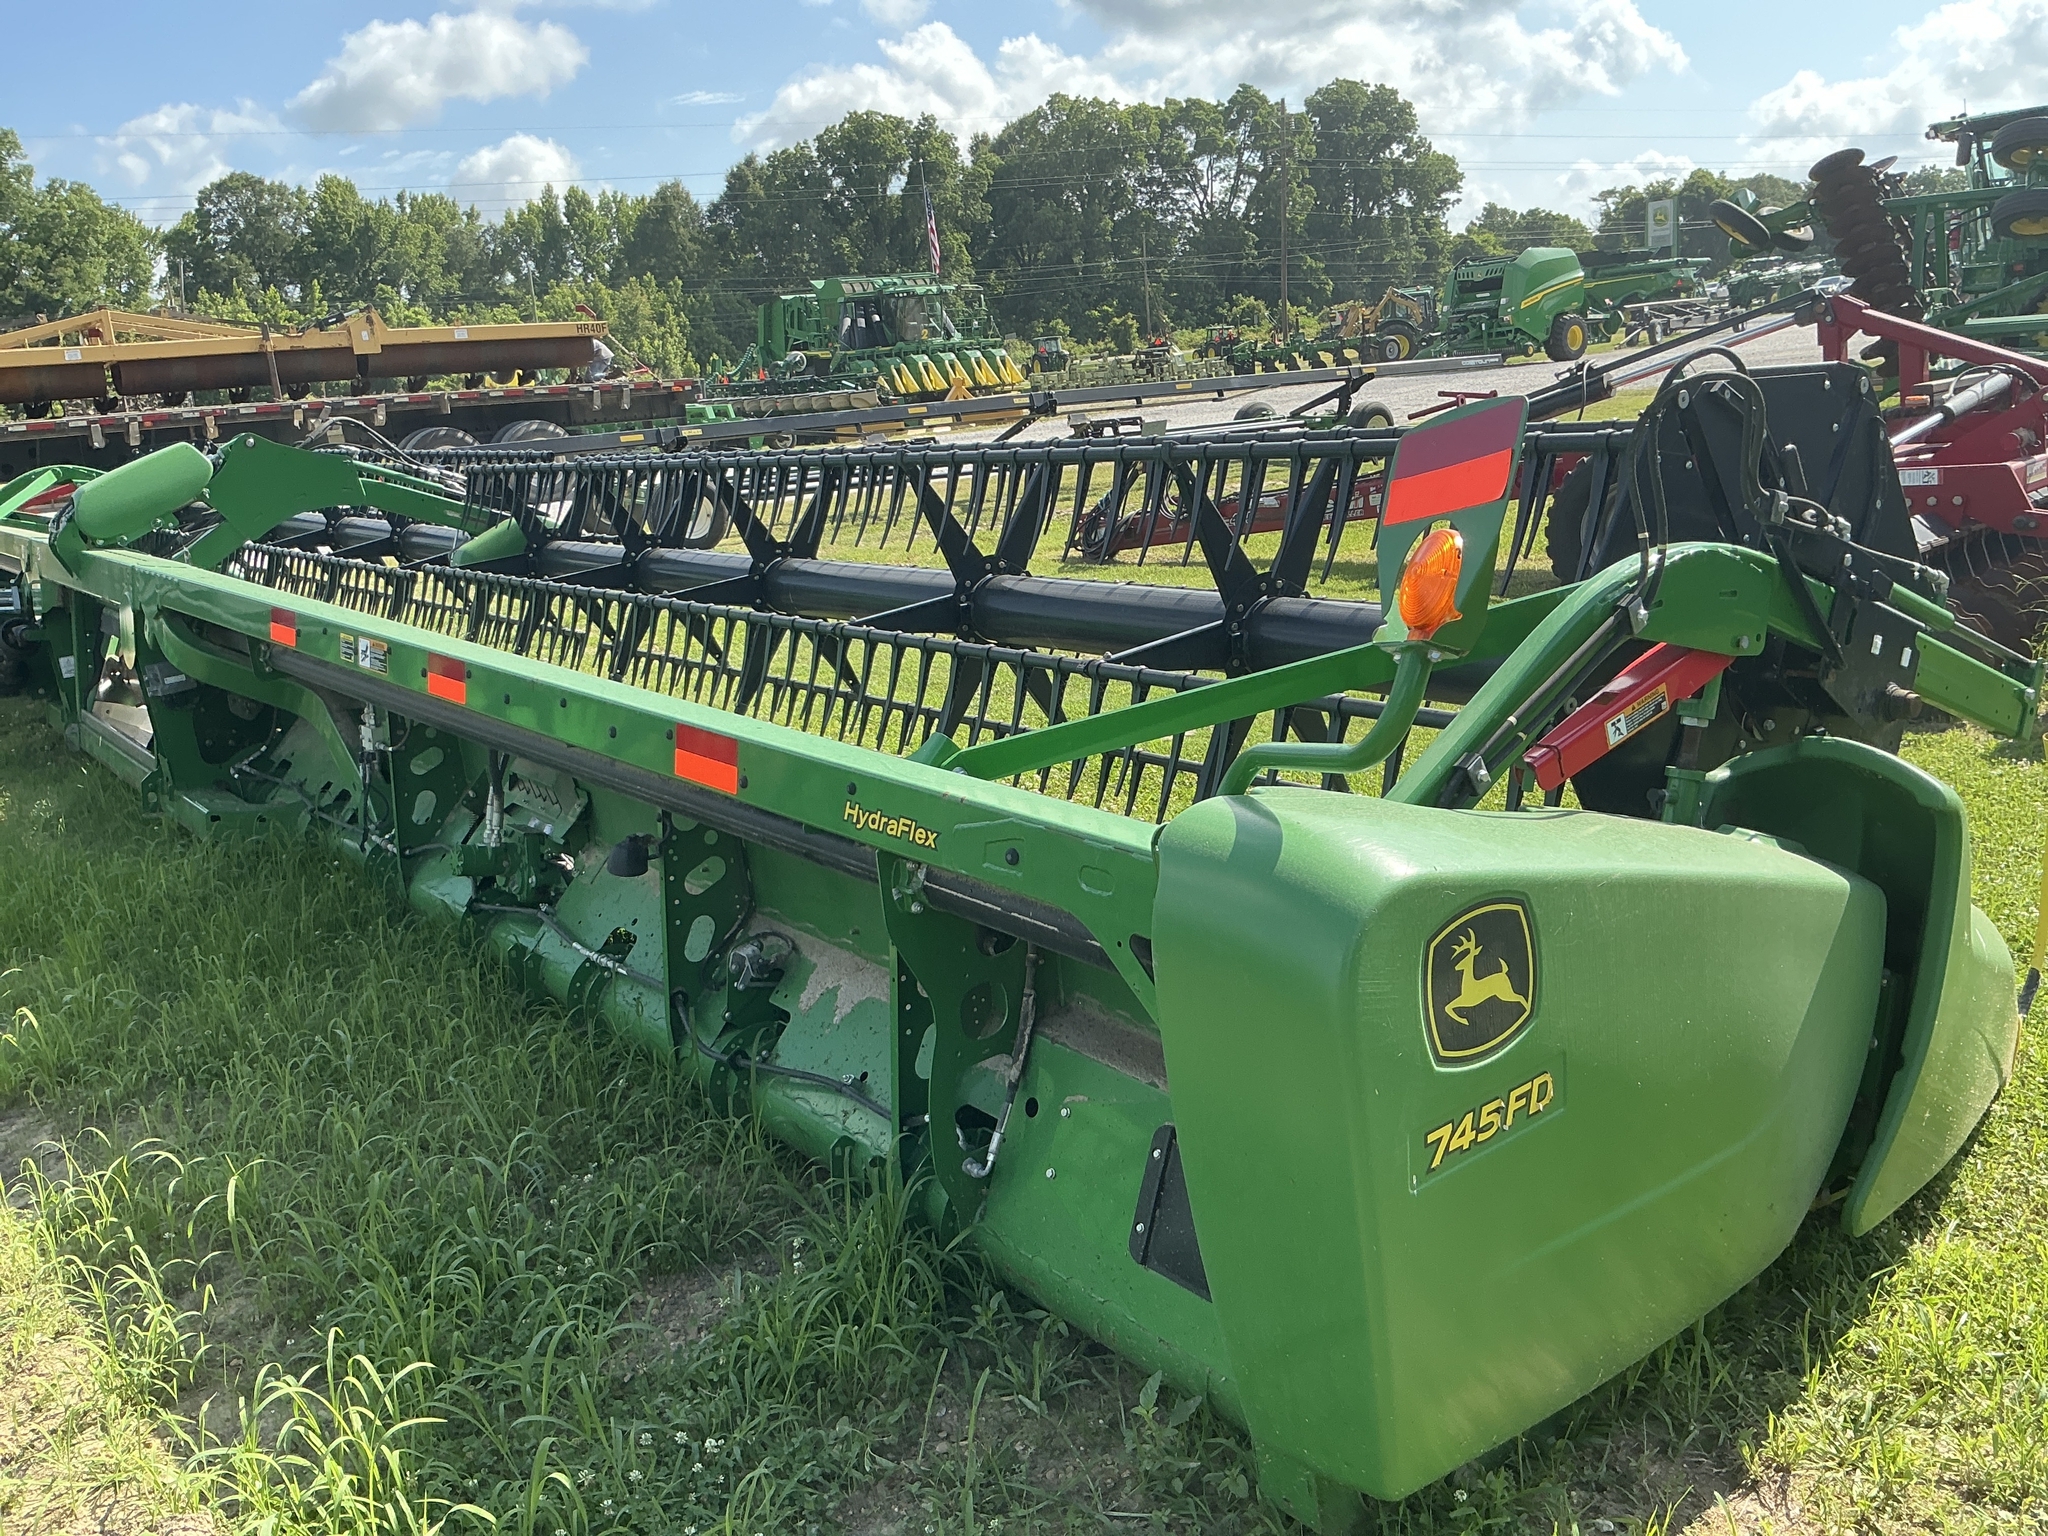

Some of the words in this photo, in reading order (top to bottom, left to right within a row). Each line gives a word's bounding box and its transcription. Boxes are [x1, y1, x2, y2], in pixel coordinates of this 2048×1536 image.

[576, 322, 607, 334] HR40F
[843, 800, 939, 850] HydraFlex
[1425, 1070, 1554, 1171] 745FD
